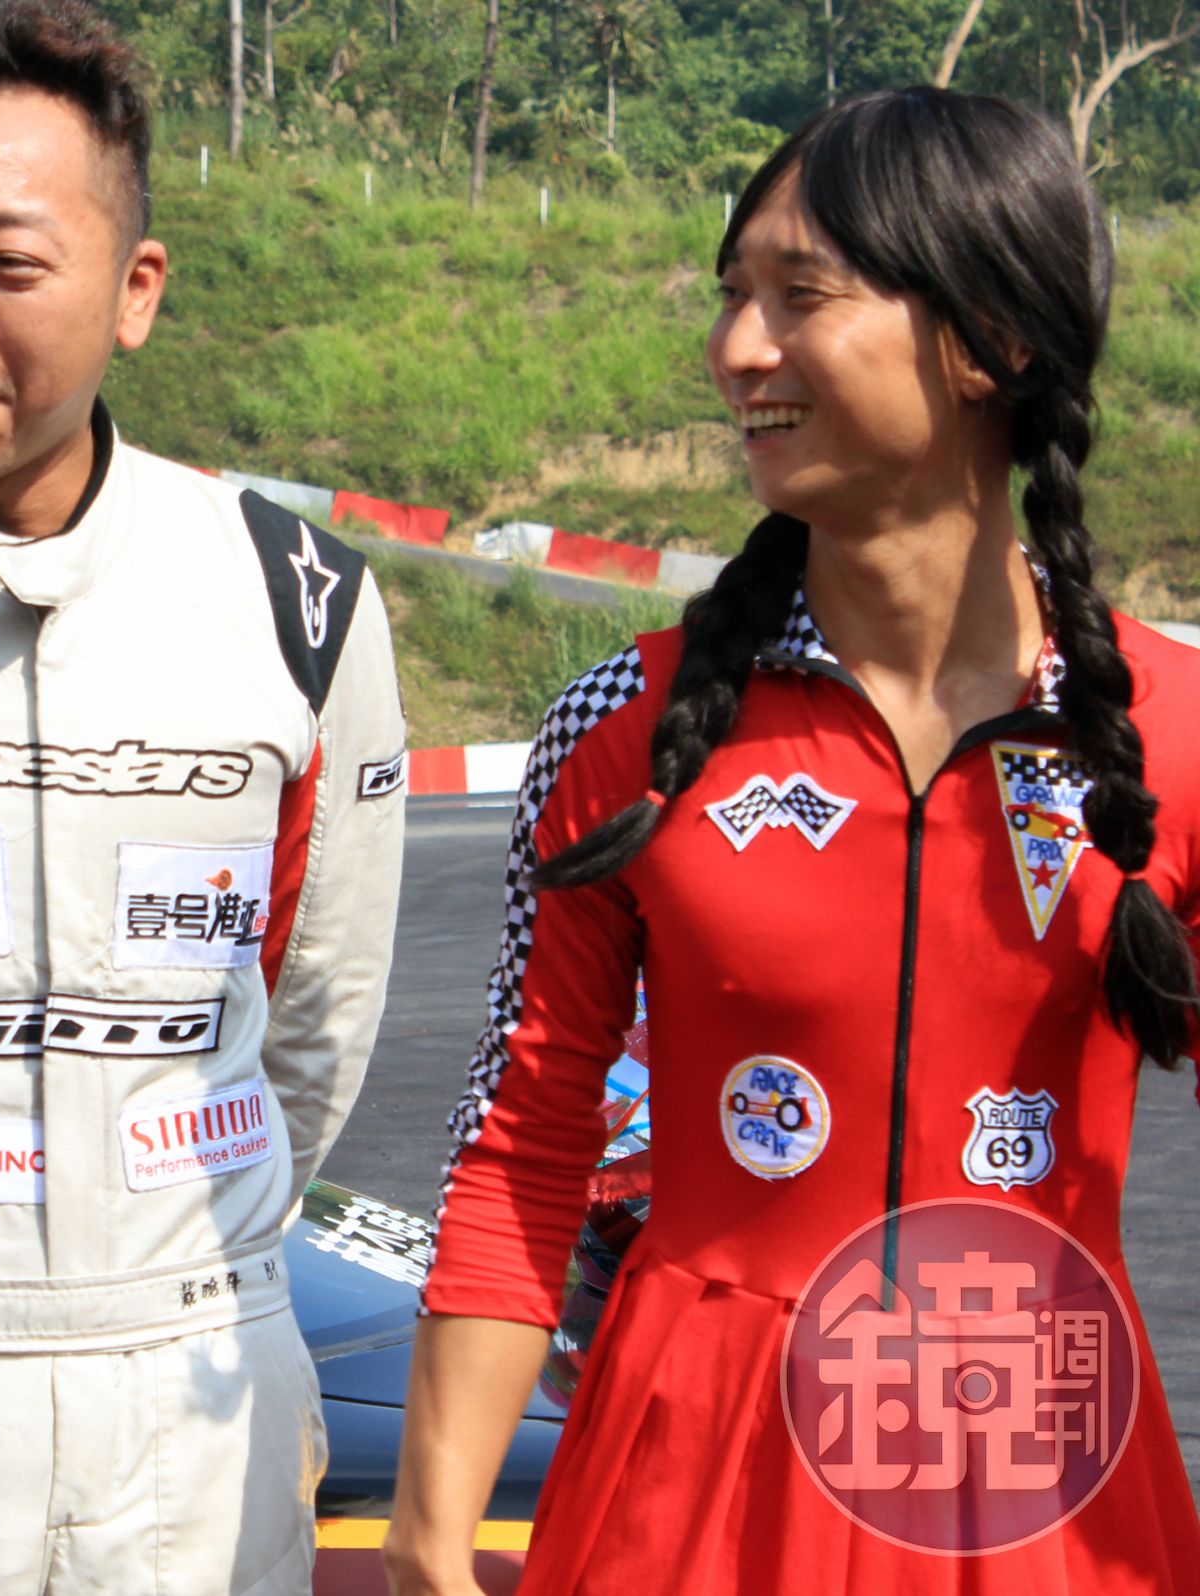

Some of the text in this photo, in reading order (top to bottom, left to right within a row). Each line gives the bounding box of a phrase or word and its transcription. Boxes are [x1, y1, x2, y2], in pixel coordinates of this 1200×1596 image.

[1027, 837, 1068, 862] PRIX
[750, 1067, 799, 1095] RACE
[988, 1107, 1044, 1128] ROUTE
[135, 1150, 229, 1178] Performance
[986, 1135, 1034, 1169] 69
